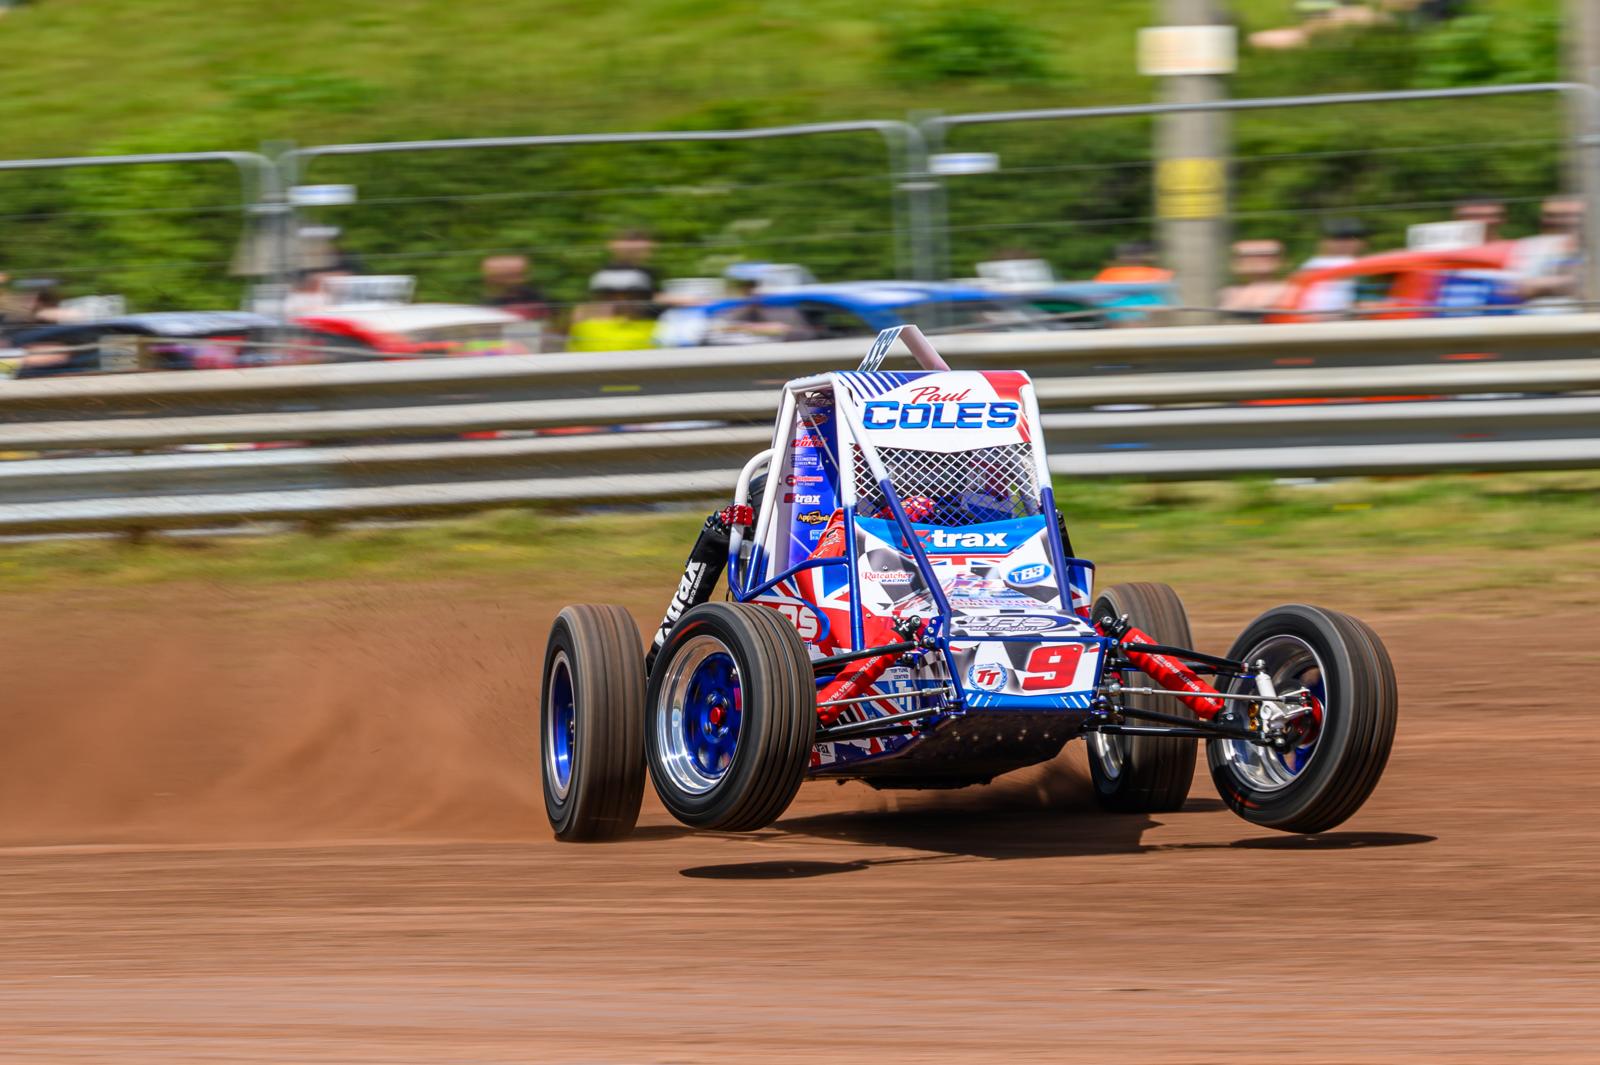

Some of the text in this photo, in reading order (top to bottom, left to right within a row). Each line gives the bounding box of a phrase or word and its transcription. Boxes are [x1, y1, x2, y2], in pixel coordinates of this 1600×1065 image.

[911, 386, 971, 404] Paul
[863, 401, 1019, 429] COLES
[861, 571, 913, 582] Ratcatcher
[977, 669, 1000, 685] TT
[1022, 645, 1084, 691] 9
